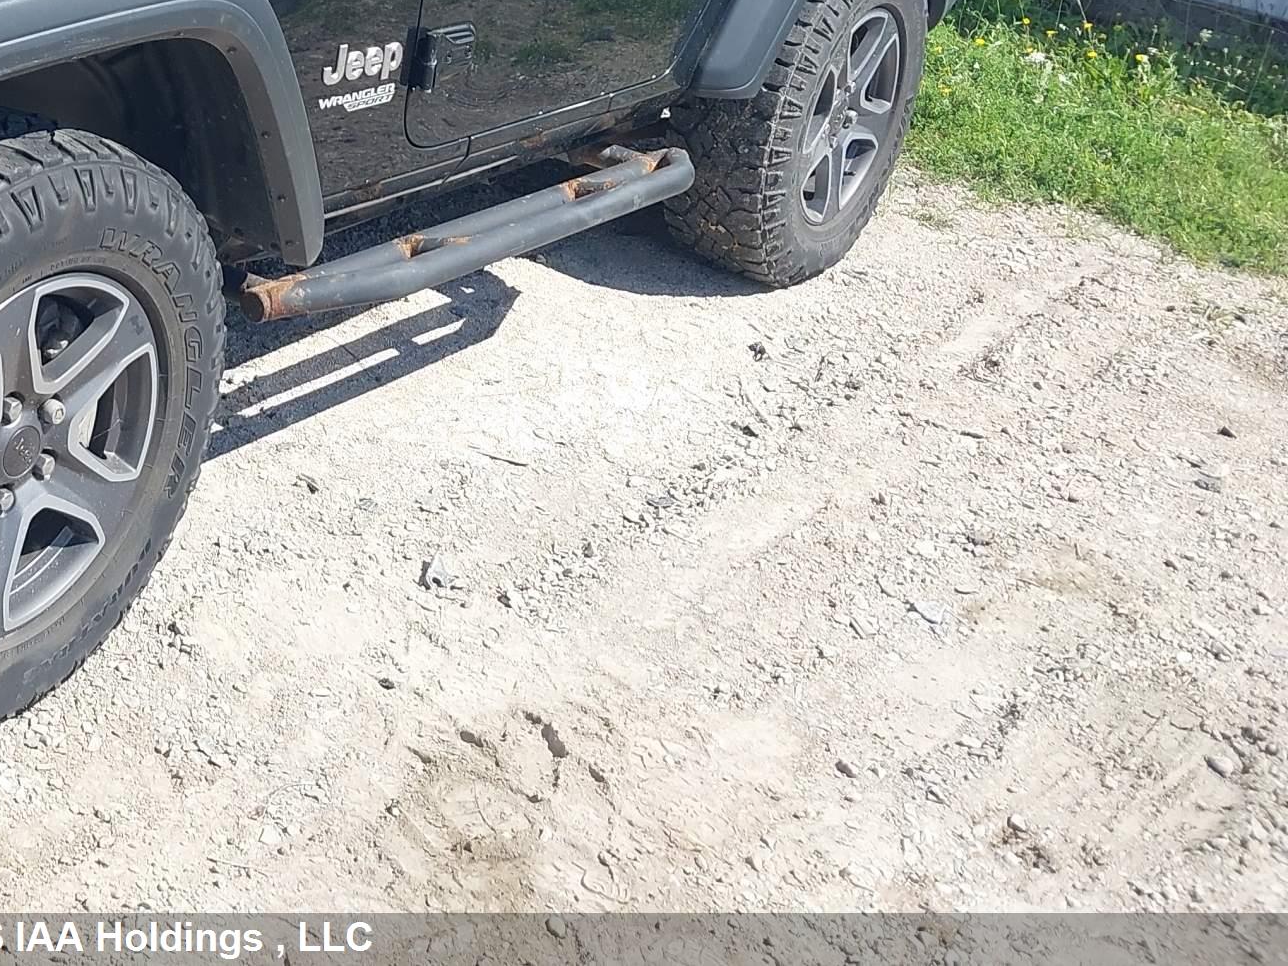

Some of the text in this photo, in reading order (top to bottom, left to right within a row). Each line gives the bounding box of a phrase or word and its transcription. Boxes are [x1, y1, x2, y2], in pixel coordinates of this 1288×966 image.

[323, 42, 403, 86] Jeep
[319, 83, 395, 110] WRANGLER
[345, 94, 392, 111] SPORT
[99, 227, 203, 500] WRANGLER
